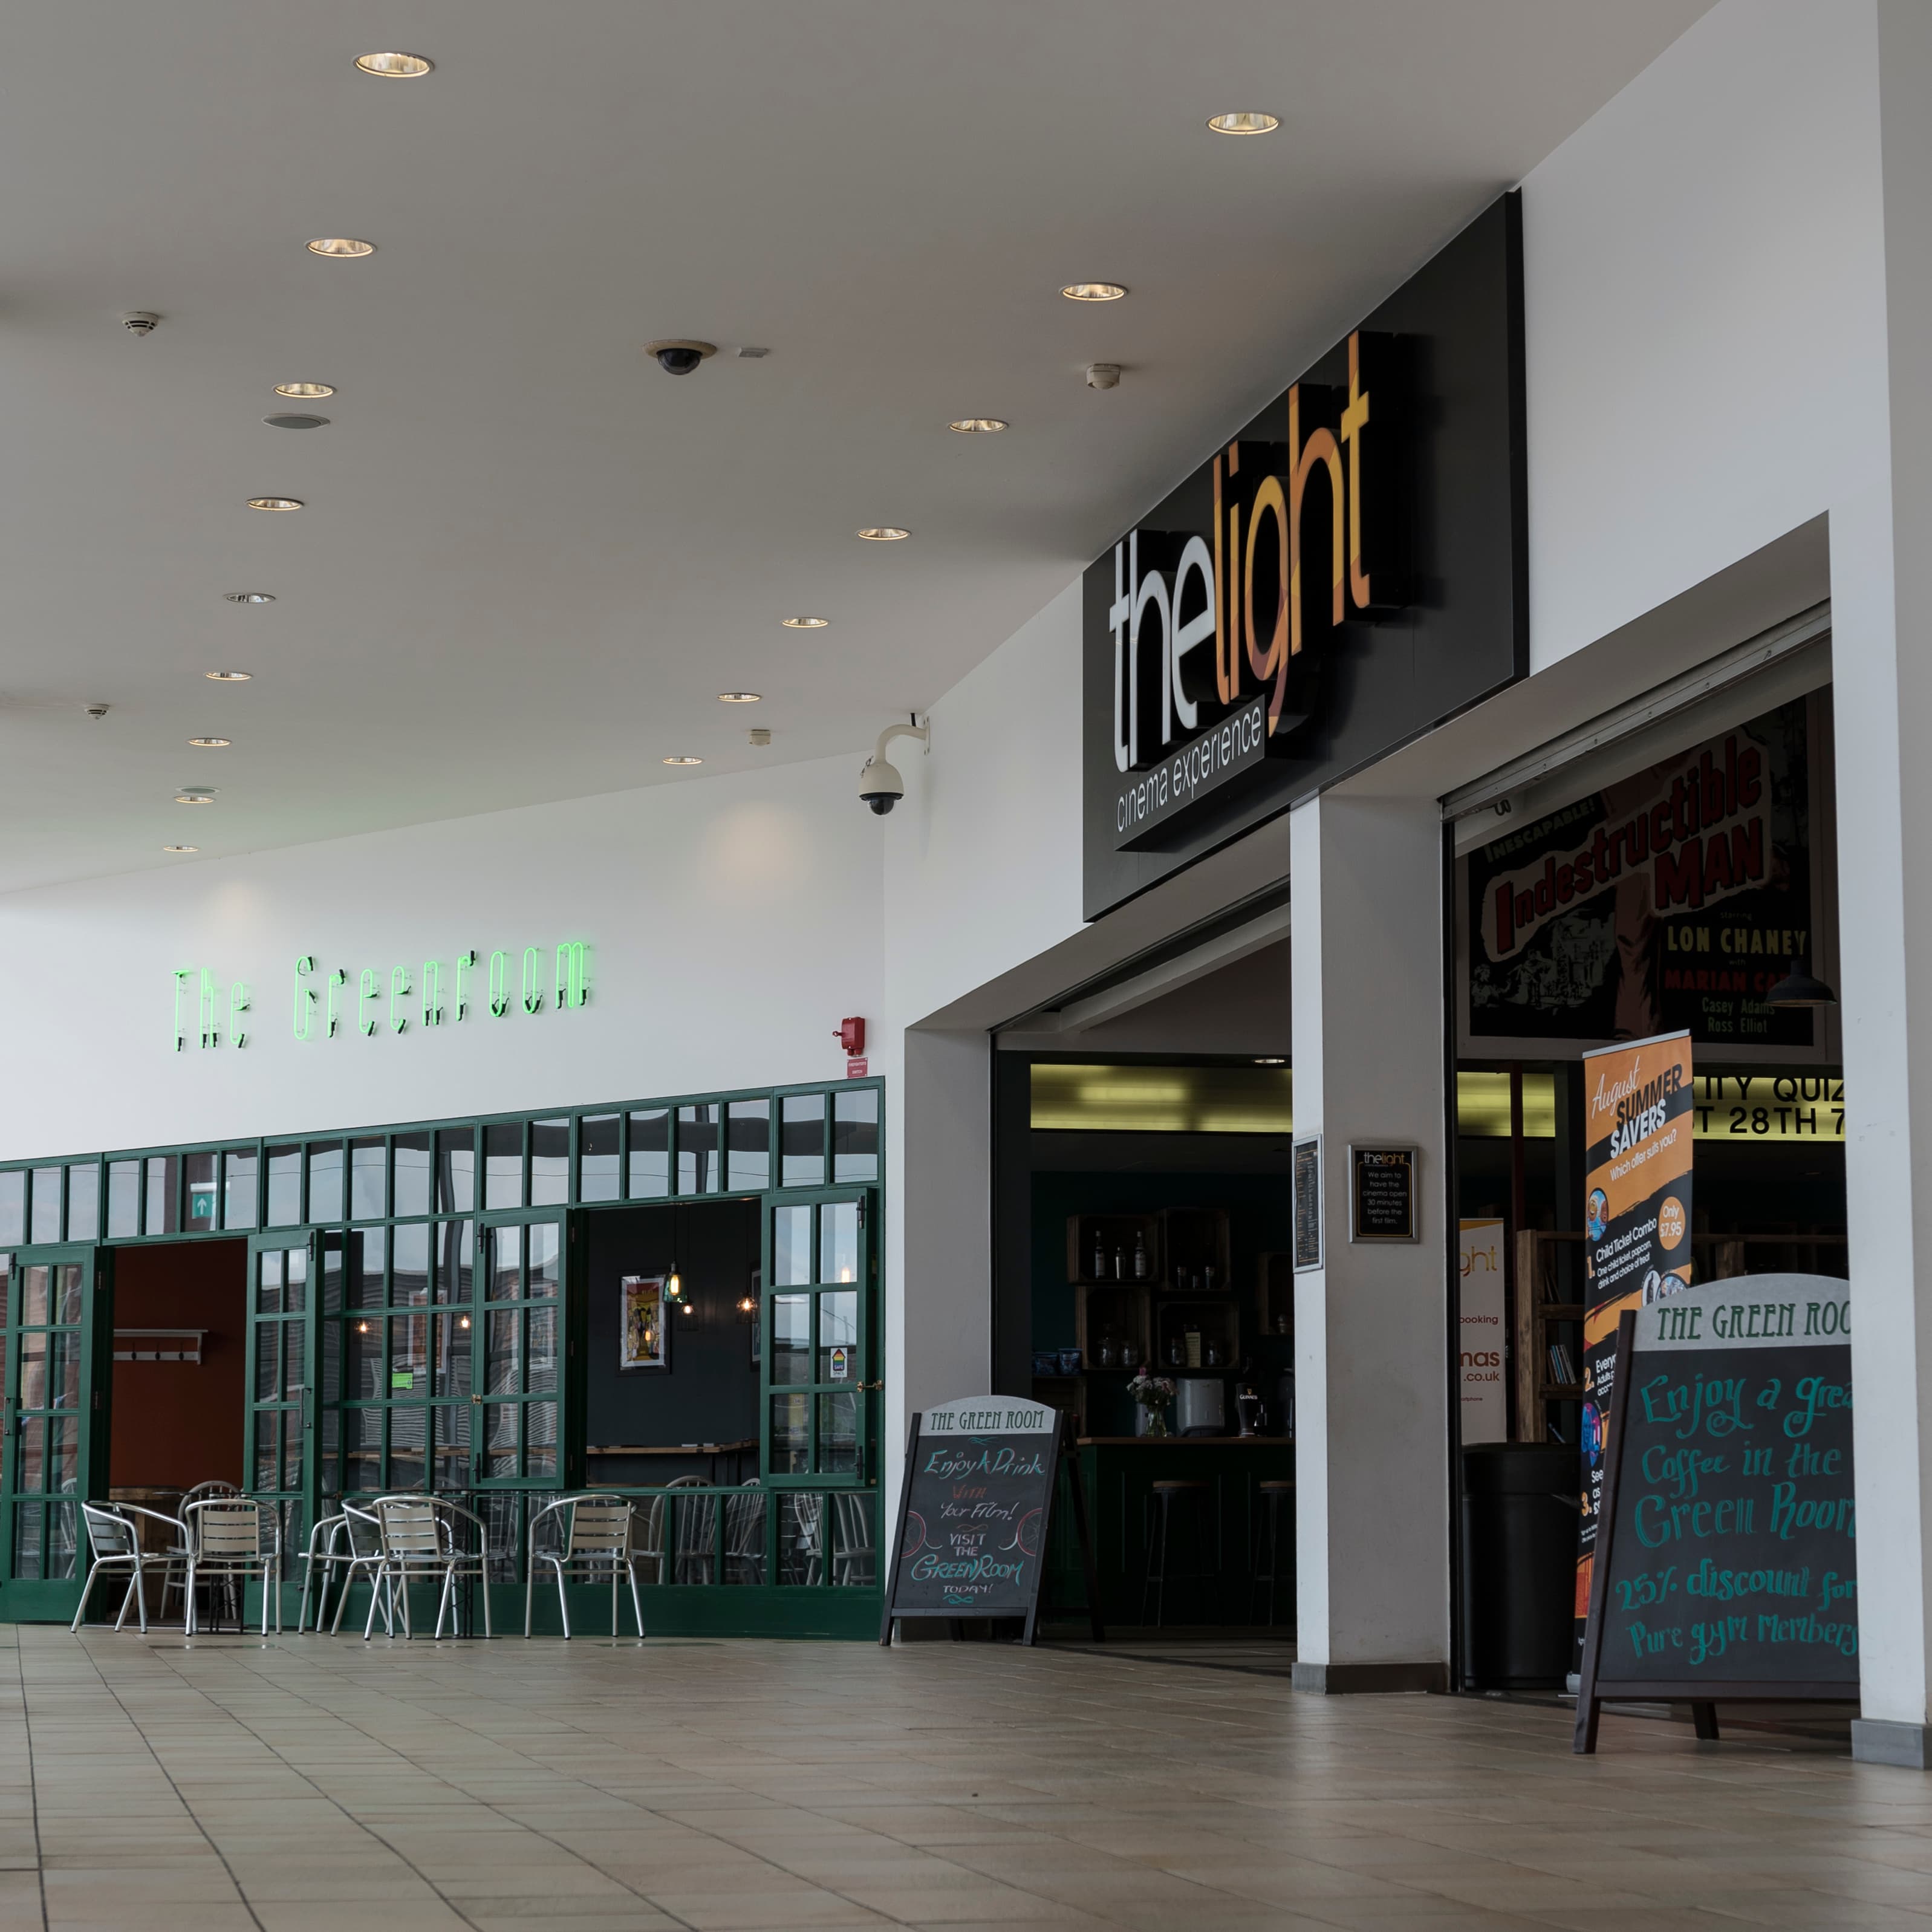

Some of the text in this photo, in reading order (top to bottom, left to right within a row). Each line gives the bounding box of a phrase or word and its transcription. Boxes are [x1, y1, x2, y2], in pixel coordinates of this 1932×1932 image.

[1110, 330, 1370, 773] thelight
[1117, 706, 1261, 832] cinema experience
[1495, 735, 1761, 955] Indestructible
[1654, 816, 1764, 908] MAN
[1667, 925, 1807, 955] LON CHANEY
[1664, 969, 1748, 992] MARIAN
[172, 942, 585, 1051] The Greenroom
[1702, 997, 1776, 1016] Casey Adams
[1708, 1017, 1768, 1033] Ross Elliot
[1592, 1055, 1641, 1119] August
[1616, 1064, 1682, 1125] SUMMER
[1610, 1098, 1667, 1159] SAVERS
[1692, 1106, 1714, 1133] T
[1729, 1107, 1817, 1135] 28TH
[1364, 1152, 1406, 1165] thelight
[1610, 1128, 1677, 1181] Which offer suits you?
[1663, 1206, 1679, 1220] Only
[1596, 1218, 1657, 1263] Child Ticket Combo
[1660, 1221, 1682, 1238] £7.95
[1587, 1256, 1595, 1279] 1.
[1597, 1266, 1608, 1277] One
[1607, 1258, 1619, 1273] child
[1598, 1277, 1609, 1290] drink
[1609, 1271, 1619, 1283] and
[1619, 1264, 1634, 1278] choice
[1639, 1252, 1650, 1267] treat
[1657, 1306, 1702, 1340] THE
[1712, 1303, 1796, 1339] GREEN
[1463, 1371, 1500, 1382] .co.uk
[1585, 1367, 1595, 1392] 2.
[931, 1410, 1045, 1430] THE GREEN ROOM
[1641, 1374, 1754, 1439] Enjoy
[1757, 1379, 1781, 1410] a
[924, 1447, 1046, 1480] Enjoy A Drink
[1592, 1469, 1604, 1483] See
[1642, 1442, 1843, 1500] Coffee in the
[940, 1502, 971, 1519] Your
[1581, 1491, 1592, 1517] 3.
[1634, 1495, 1757, 1548] Green
[949, 1533, 986, 1546] VISIT
[954, 1546, 978, 1556] THE
[943, 1584, 994, 1594] TODAY!
[1615, 1558, 1857, 1612] 25% discount for
[1625, 1621, 1683, 1659] Pure
